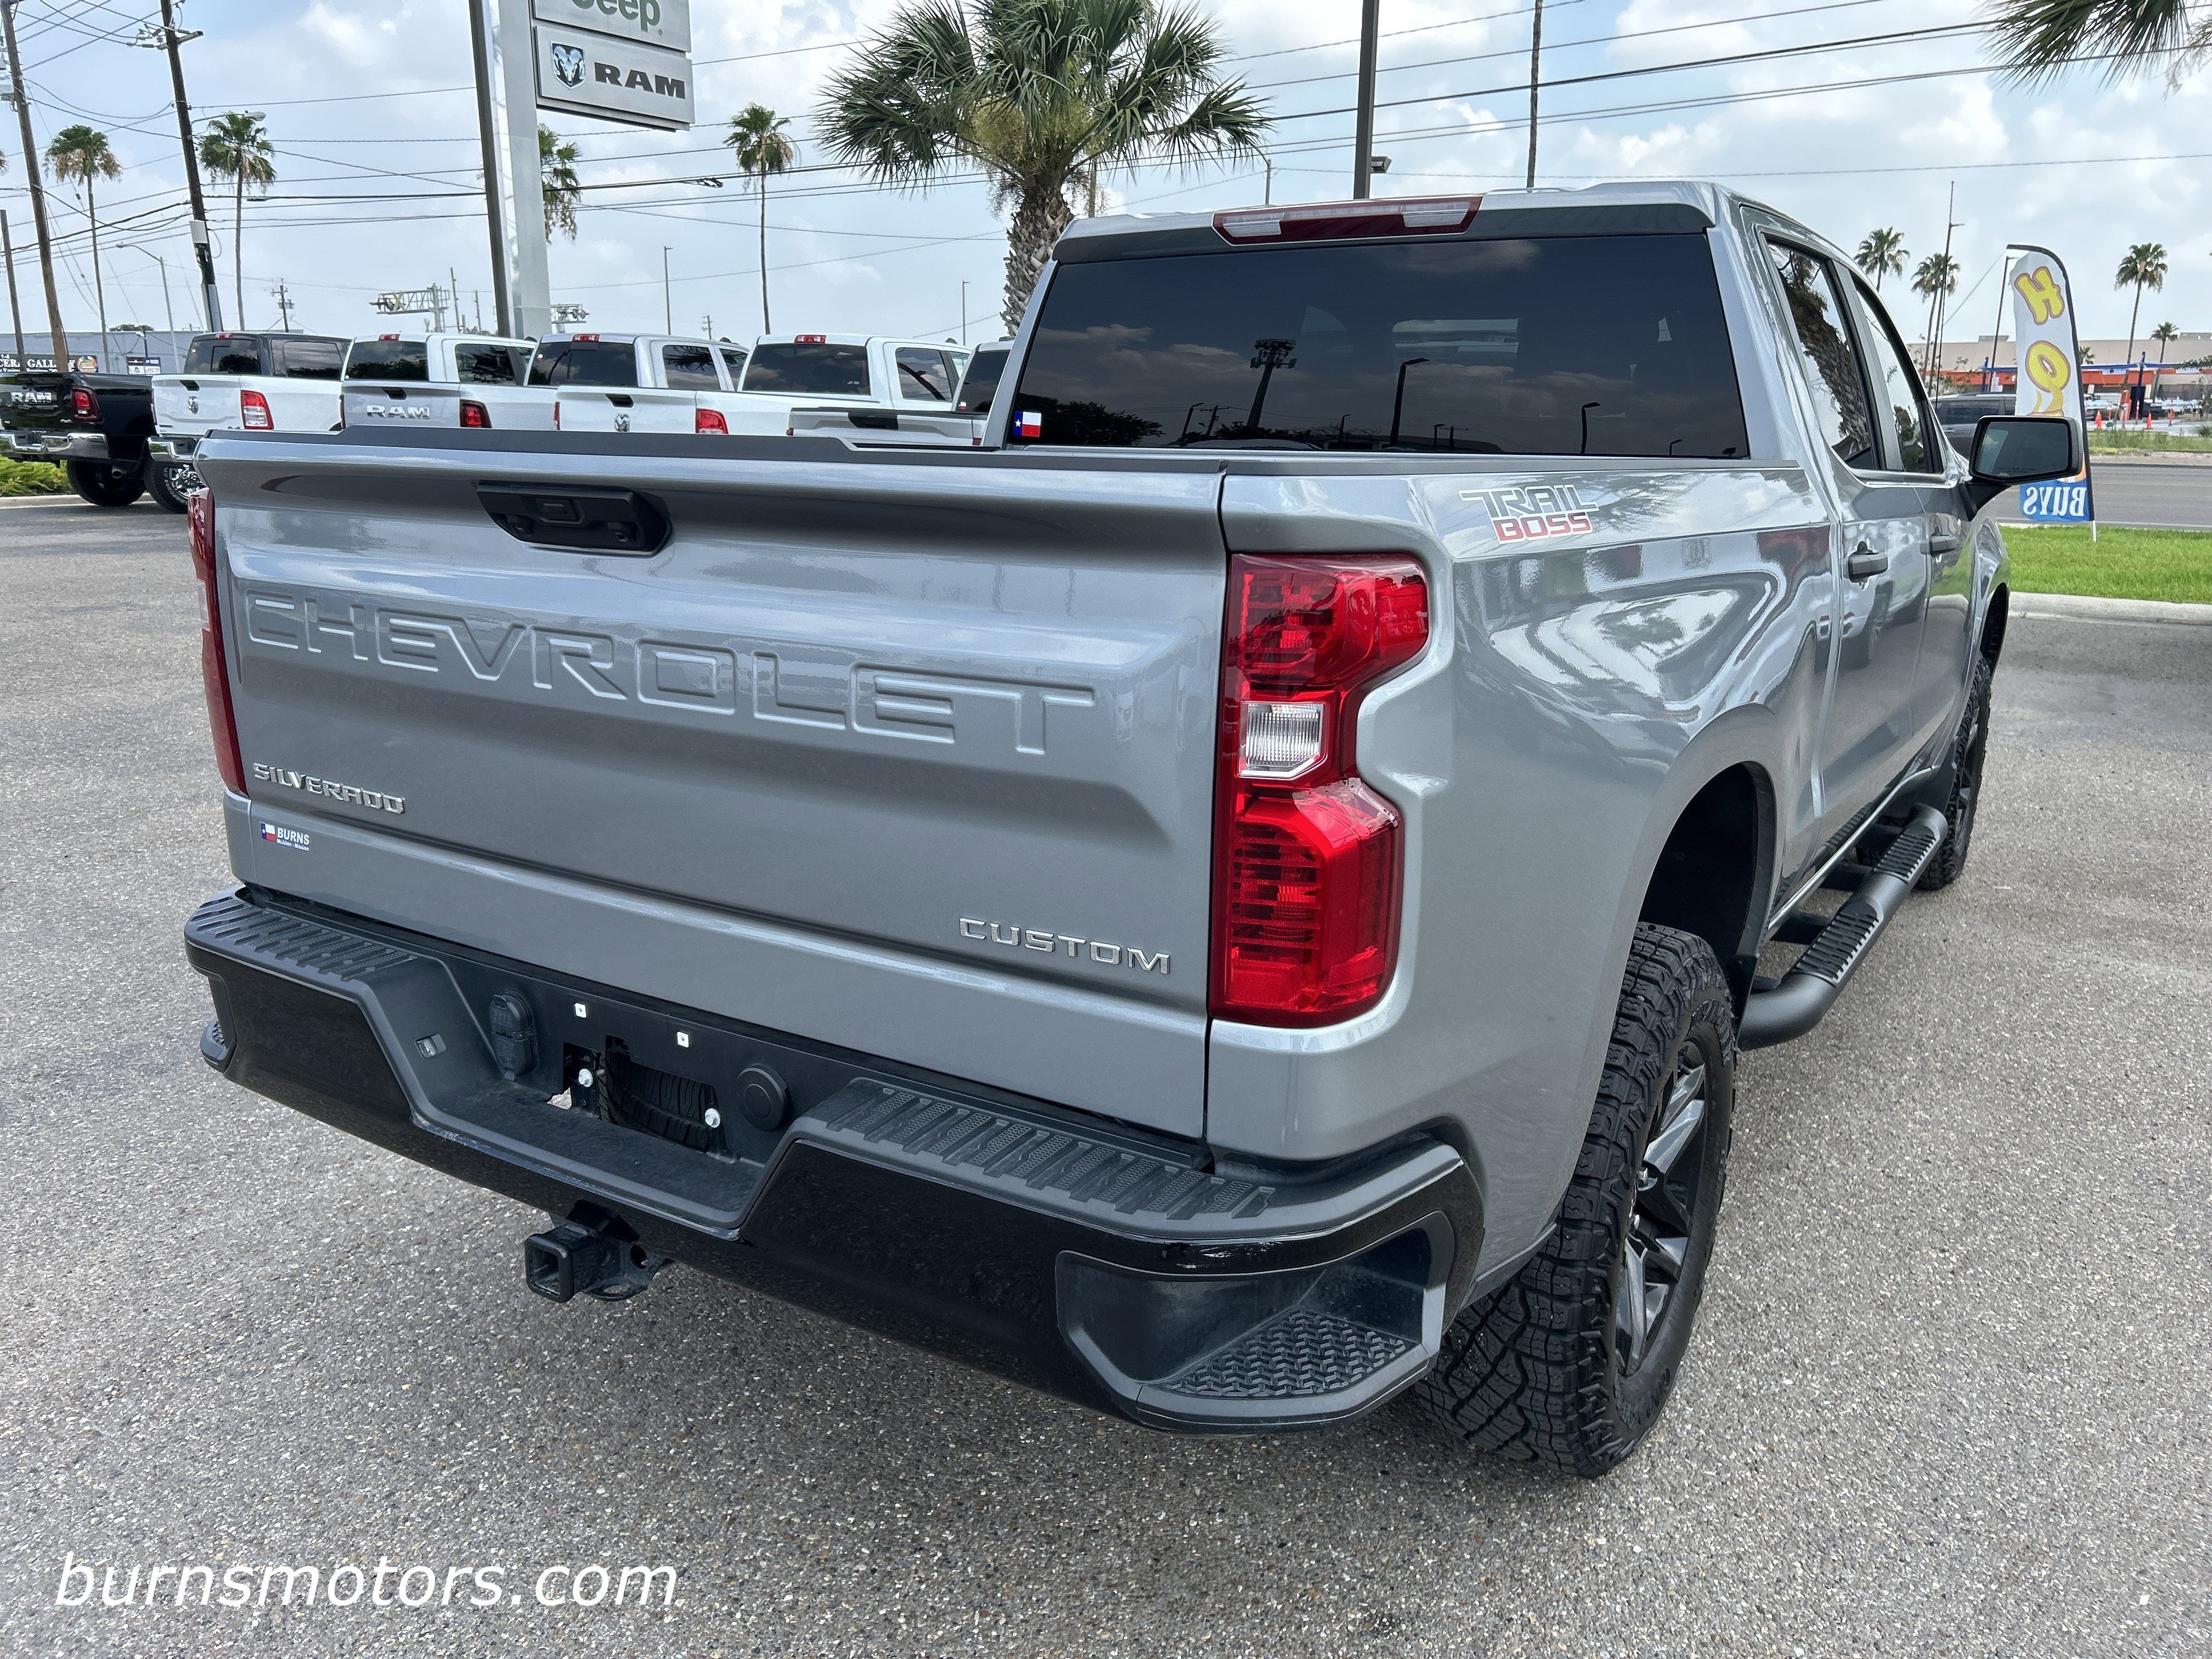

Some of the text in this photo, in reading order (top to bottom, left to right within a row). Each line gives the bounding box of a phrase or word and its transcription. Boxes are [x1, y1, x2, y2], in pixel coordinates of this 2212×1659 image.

[572, 0, 661, 33] eep
[594, 61, 686, 100] RAM
[11, 392, 52, 403] RAM
[366, 404, 430, 420] RAM
[1458, 484, 1599, 518] TRAIL
[1492, 512, 1593, 544] BOSS
[245, 588, 1095, 755] CHEVROLET
[253, 761, 405, 815] SILVERADO
[278, 827, 309, 845] BURNS
[959, 917, 1171, 976] CUSTOM
